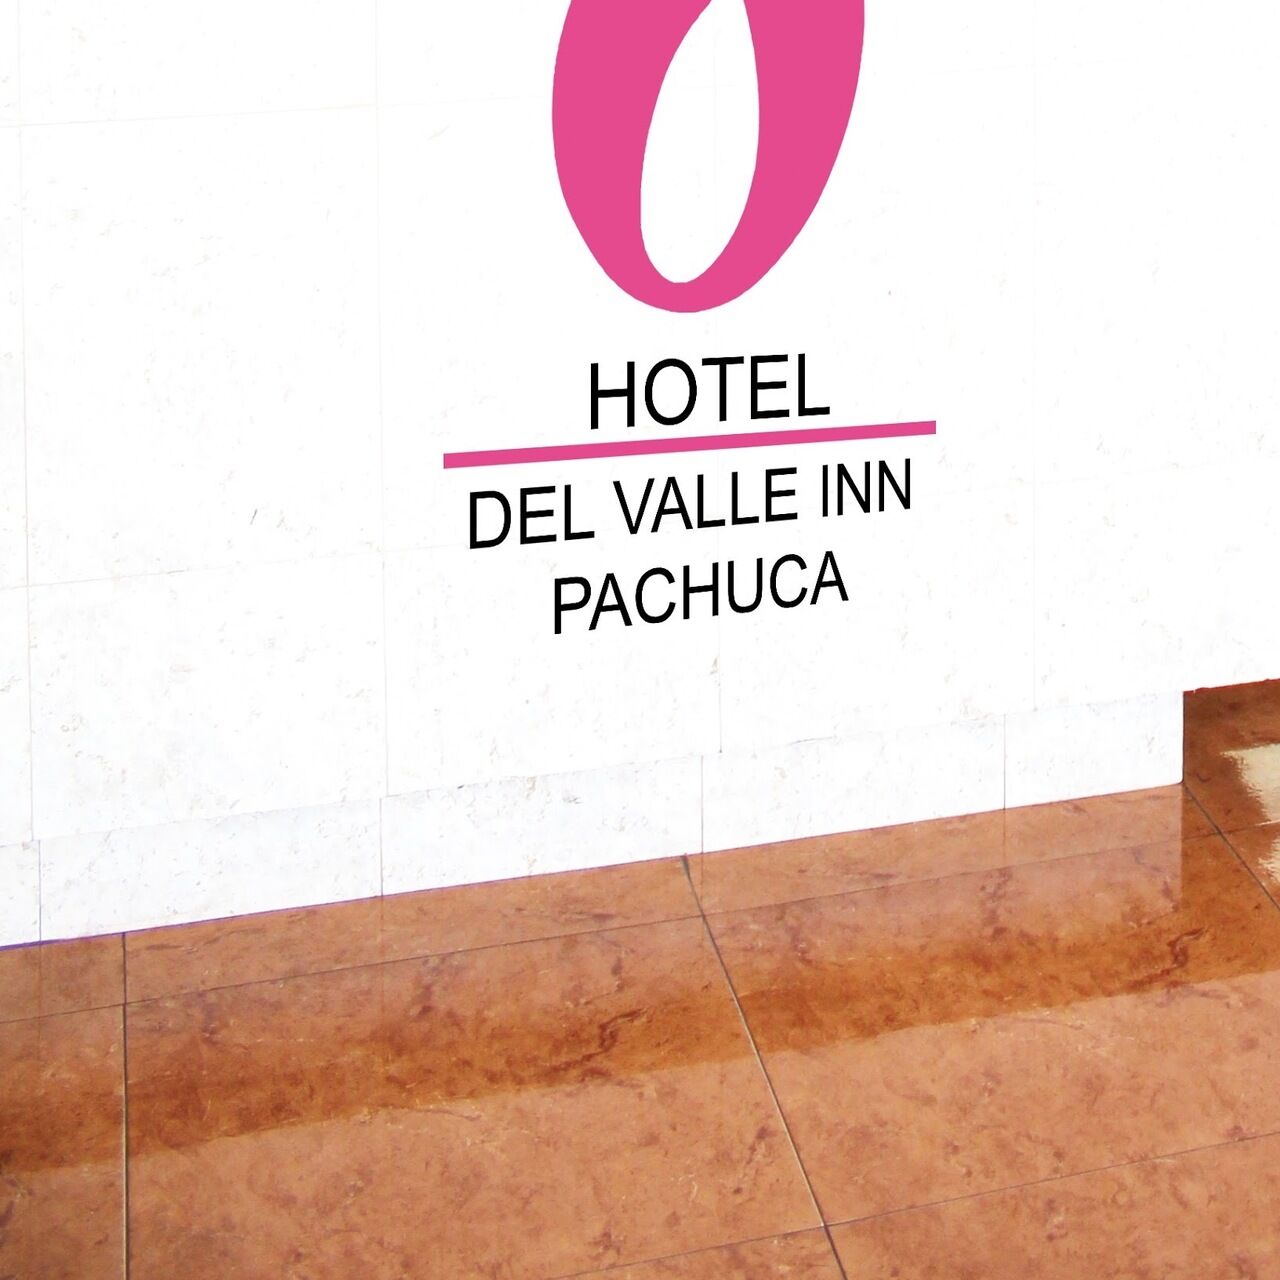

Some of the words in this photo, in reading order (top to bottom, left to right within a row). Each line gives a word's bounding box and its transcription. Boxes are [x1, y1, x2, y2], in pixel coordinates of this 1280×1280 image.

[590, 353, 830, 430] HOTEL
[469, 484, 595, 549] DEL
[613, 467, 798, 535] VALLE
[821, 458, 912, 518] INN
[554, 550, 849, 635] PACHUCA
